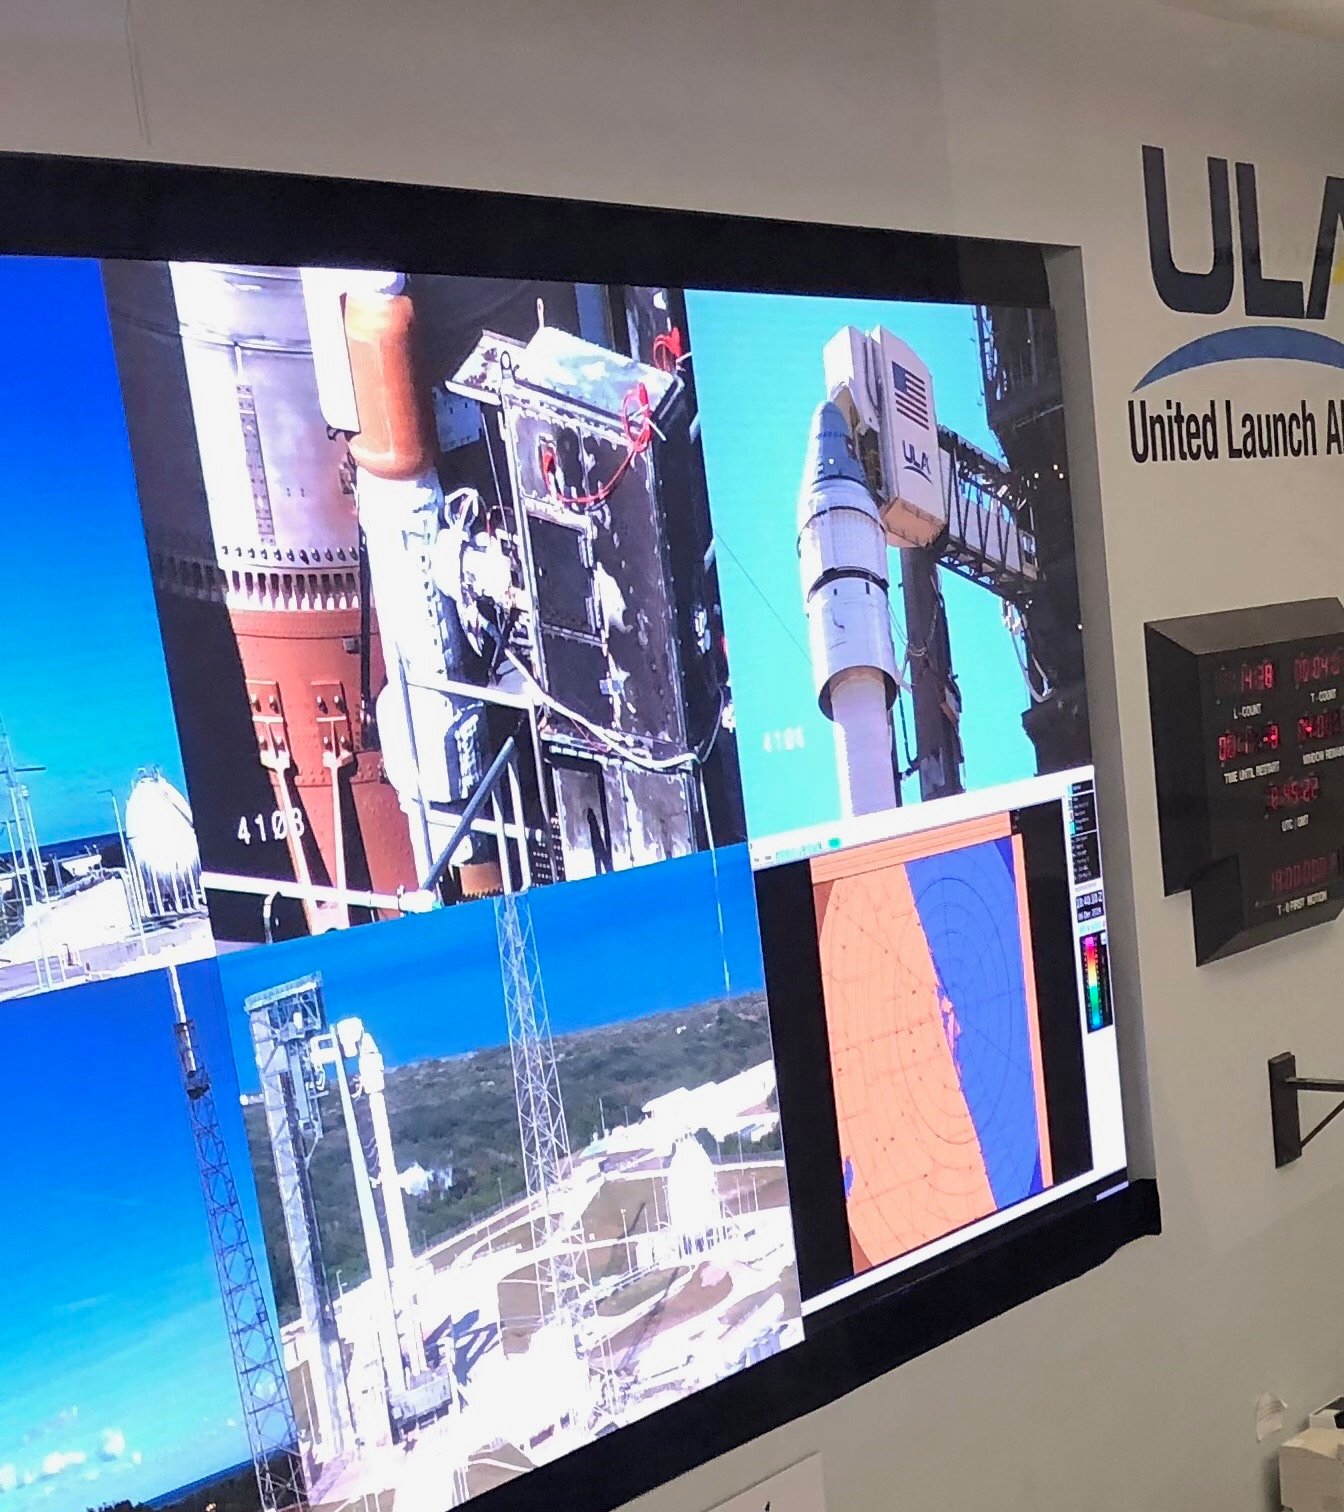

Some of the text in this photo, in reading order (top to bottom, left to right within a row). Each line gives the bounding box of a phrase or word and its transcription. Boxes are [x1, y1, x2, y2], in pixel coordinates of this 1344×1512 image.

[1127, 397, 1218, 464] United
[1227, 399, 1317, 459] Launch
[901, 440, 931, 475] ULA
